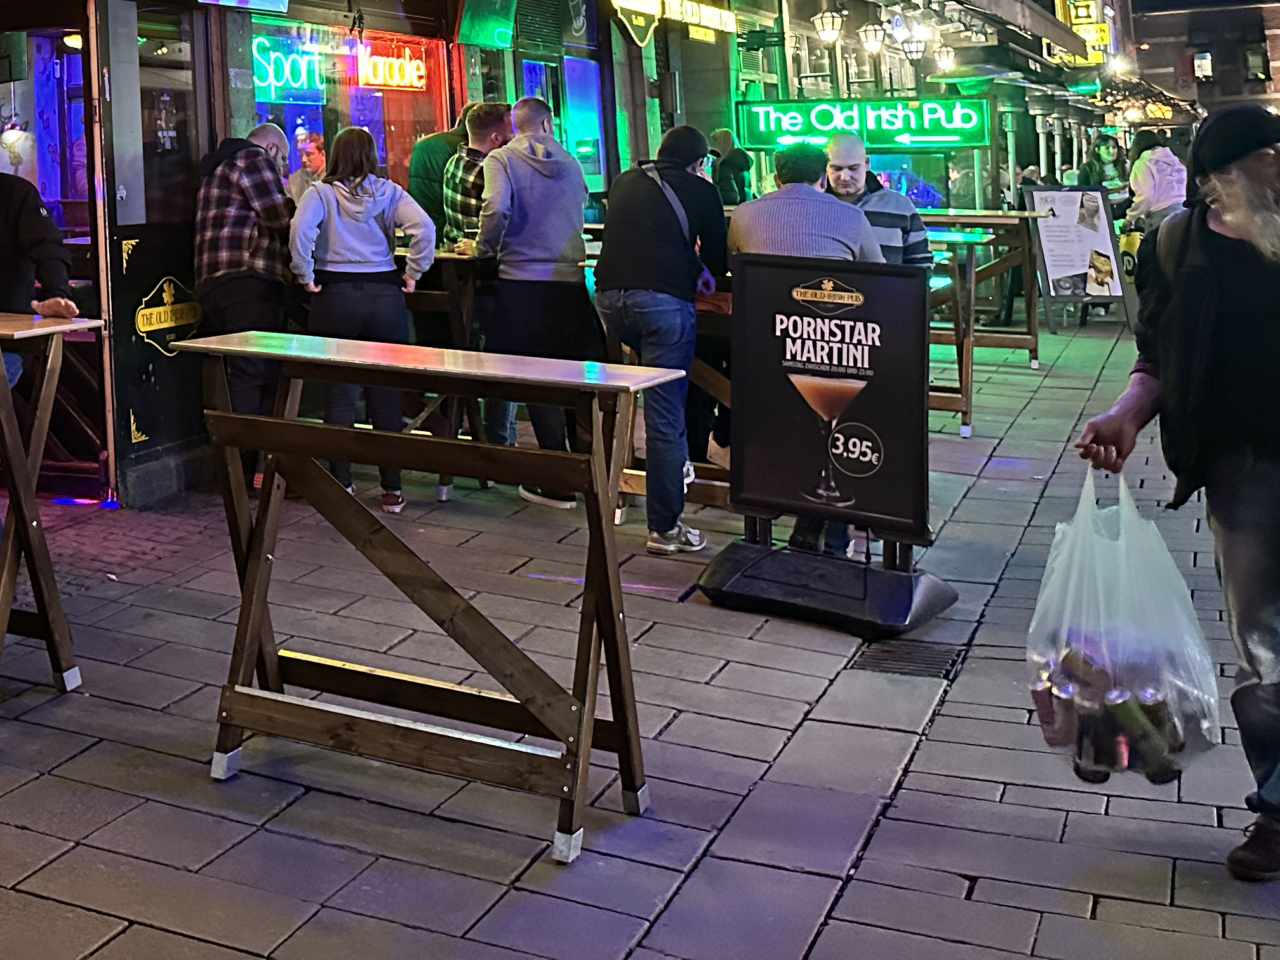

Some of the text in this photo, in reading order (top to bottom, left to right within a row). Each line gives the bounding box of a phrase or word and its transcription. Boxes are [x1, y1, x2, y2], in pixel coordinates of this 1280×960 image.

[251, 36, 327, 101] Sport
[357, 42, 426, 88] Karaoke
[751, 101, 978, 132] The Old Irish Pub
[795, 290, 809, 298] THE
[810, 290, 826, 300] OLD
[846, 294, 862, 302] PUB
[141, 312, 155, 328] THE
[156, 309, 169, 325] OLD
[775, 313, 881, 347] PORNSTAR
[785, 337, 870, 369] MARTINI
